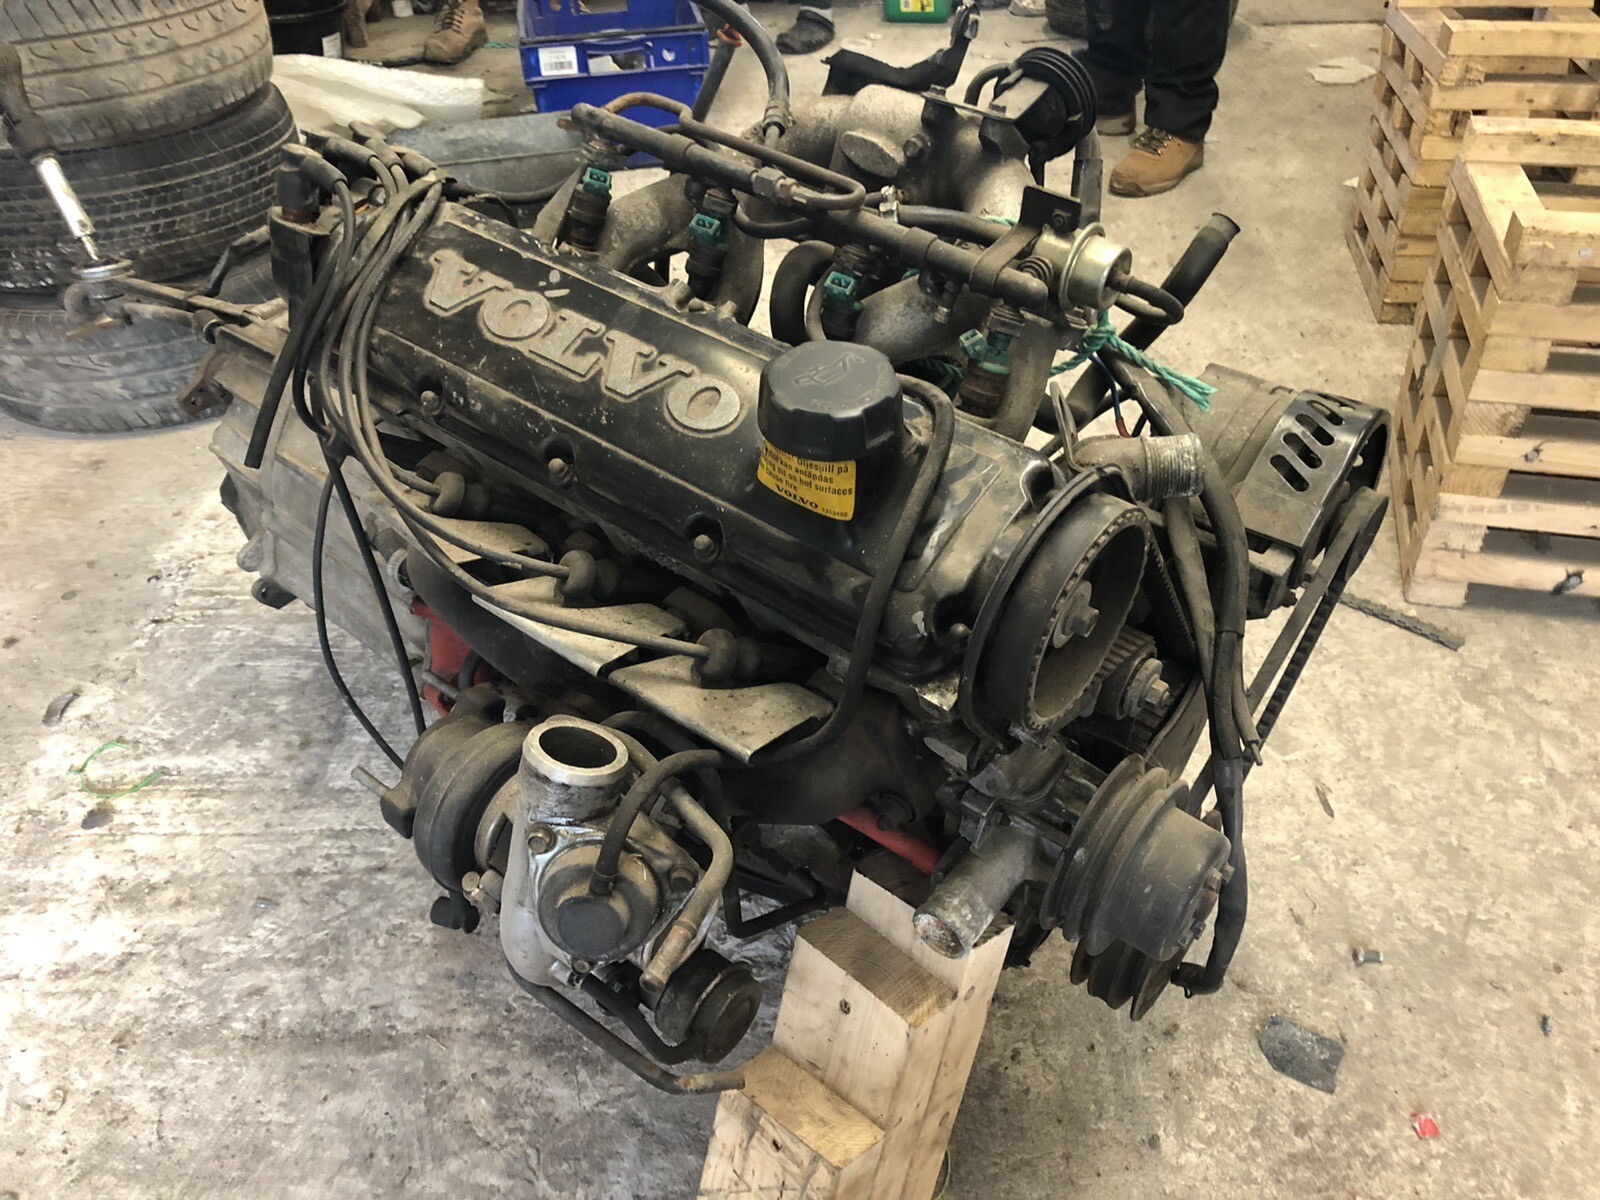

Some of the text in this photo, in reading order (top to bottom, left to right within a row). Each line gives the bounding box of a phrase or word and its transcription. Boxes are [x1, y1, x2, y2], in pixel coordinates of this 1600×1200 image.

[425, 250, 743, 433] VOLVO
[838, 463, 849, 475] på
[775, 483, 818, 509] VOLVO
[800, 477, 812, 488] hot
[814, 484, 853, 496] surfaces
